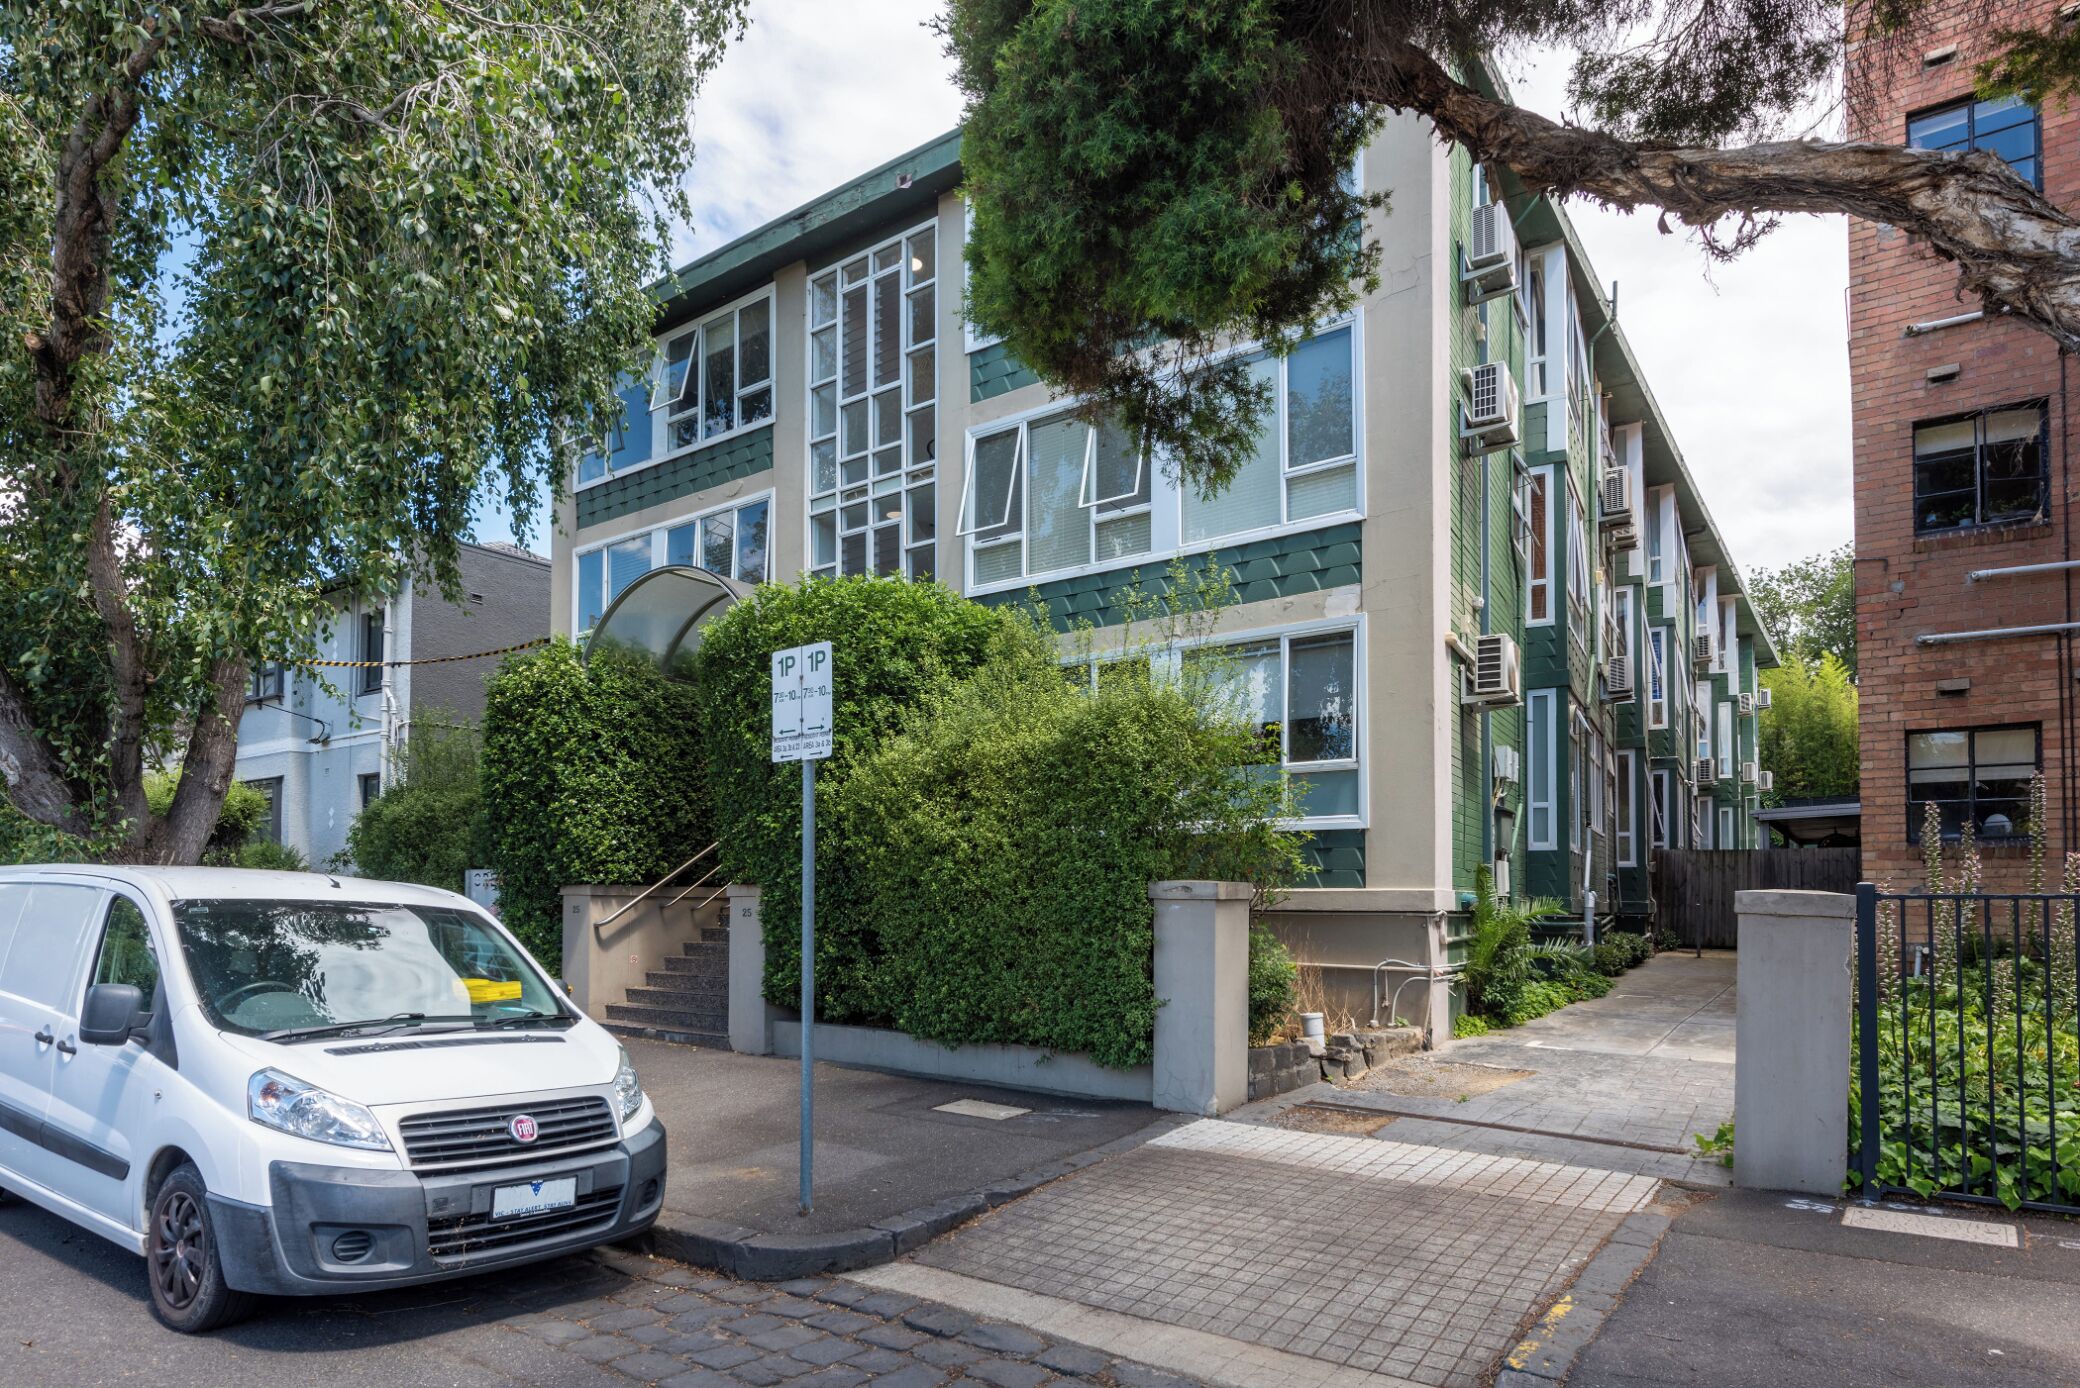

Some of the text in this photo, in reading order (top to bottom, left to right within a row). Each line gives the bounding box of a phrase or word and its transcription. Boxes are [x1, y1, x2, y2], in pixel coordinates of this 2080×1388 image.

[777, 655, 796, 677] 1P
[807, 650, 826, 672] 1P
[742, 908, 752, 917] 25
[517, 1122, 534, 1136] FIAT
